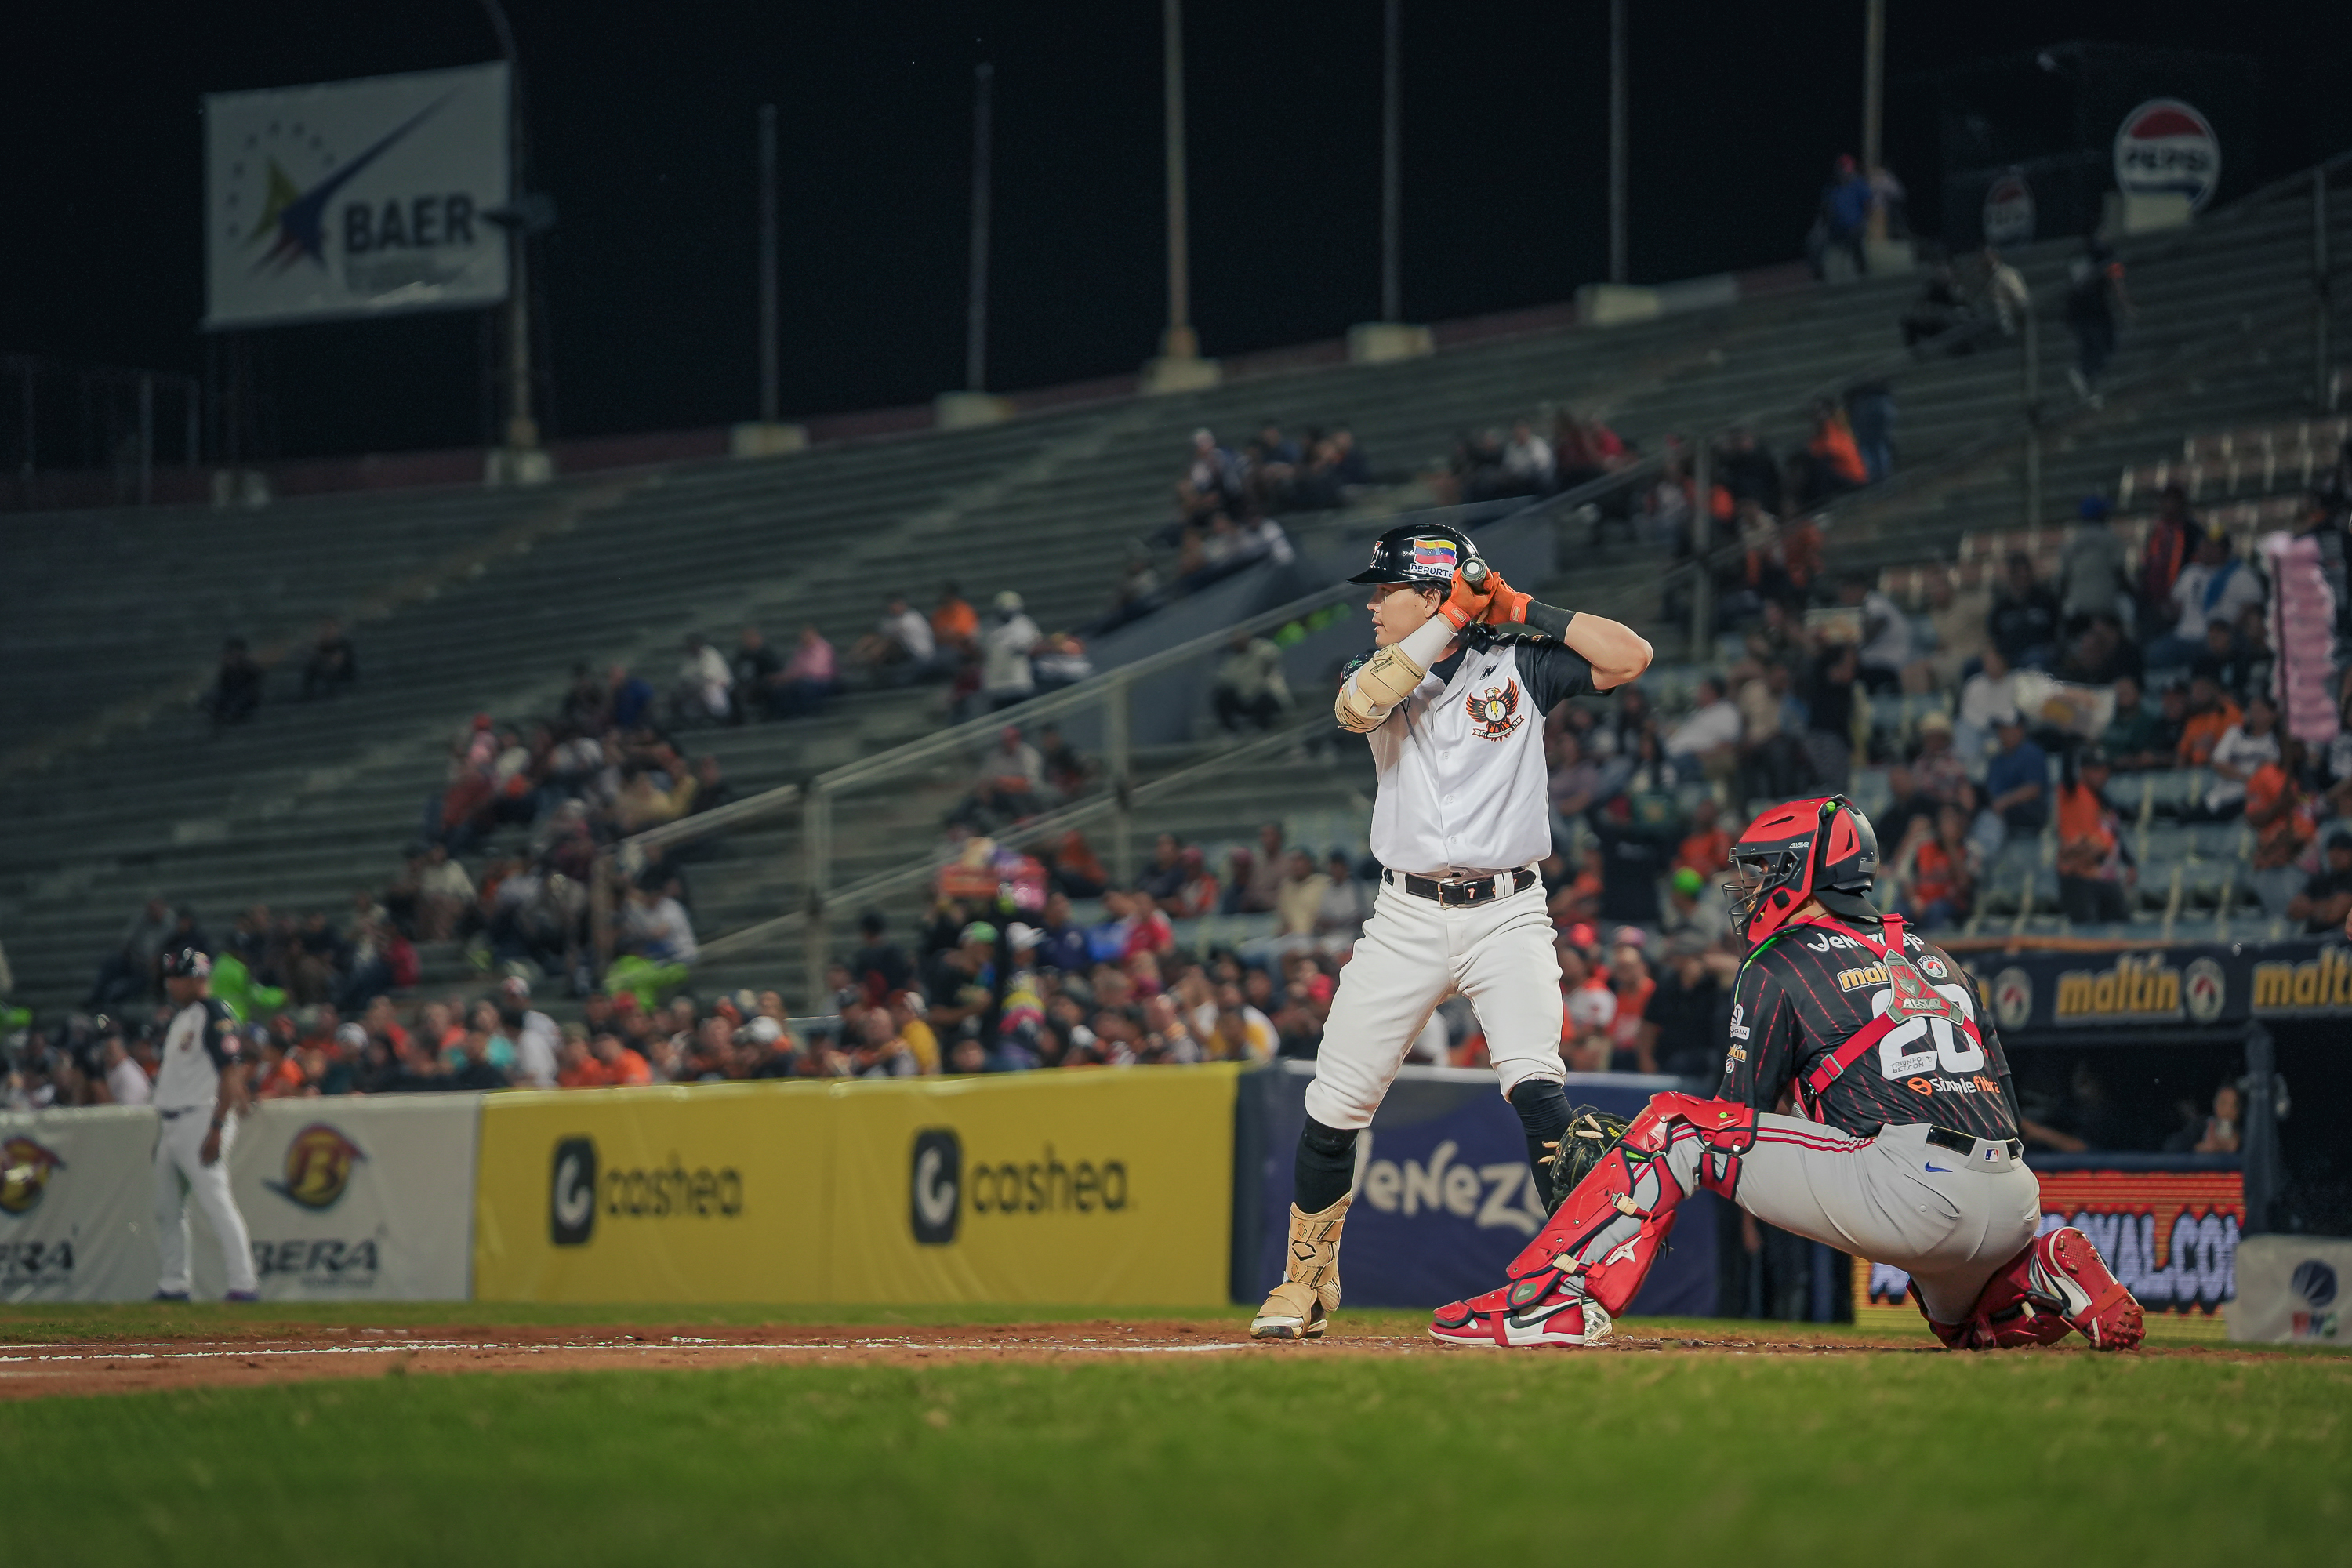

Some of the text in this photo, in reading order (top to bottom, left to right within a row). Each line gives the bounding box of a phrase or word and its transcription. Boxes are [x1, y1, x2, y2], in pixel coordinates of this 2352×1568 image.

[343, 192, 475, 253] BAER
[1411, 564, 1454, 578] DEPORTE
[1871, 983, 1985, 1080] 20
[1890, 1056, 1922, 1069] TRIUNFO
[1893, 1062, 1924, 1073] BET.COM
[603, 1149, 743, 1216] cashea
[970, 1142, 1127, 1213] cashea
